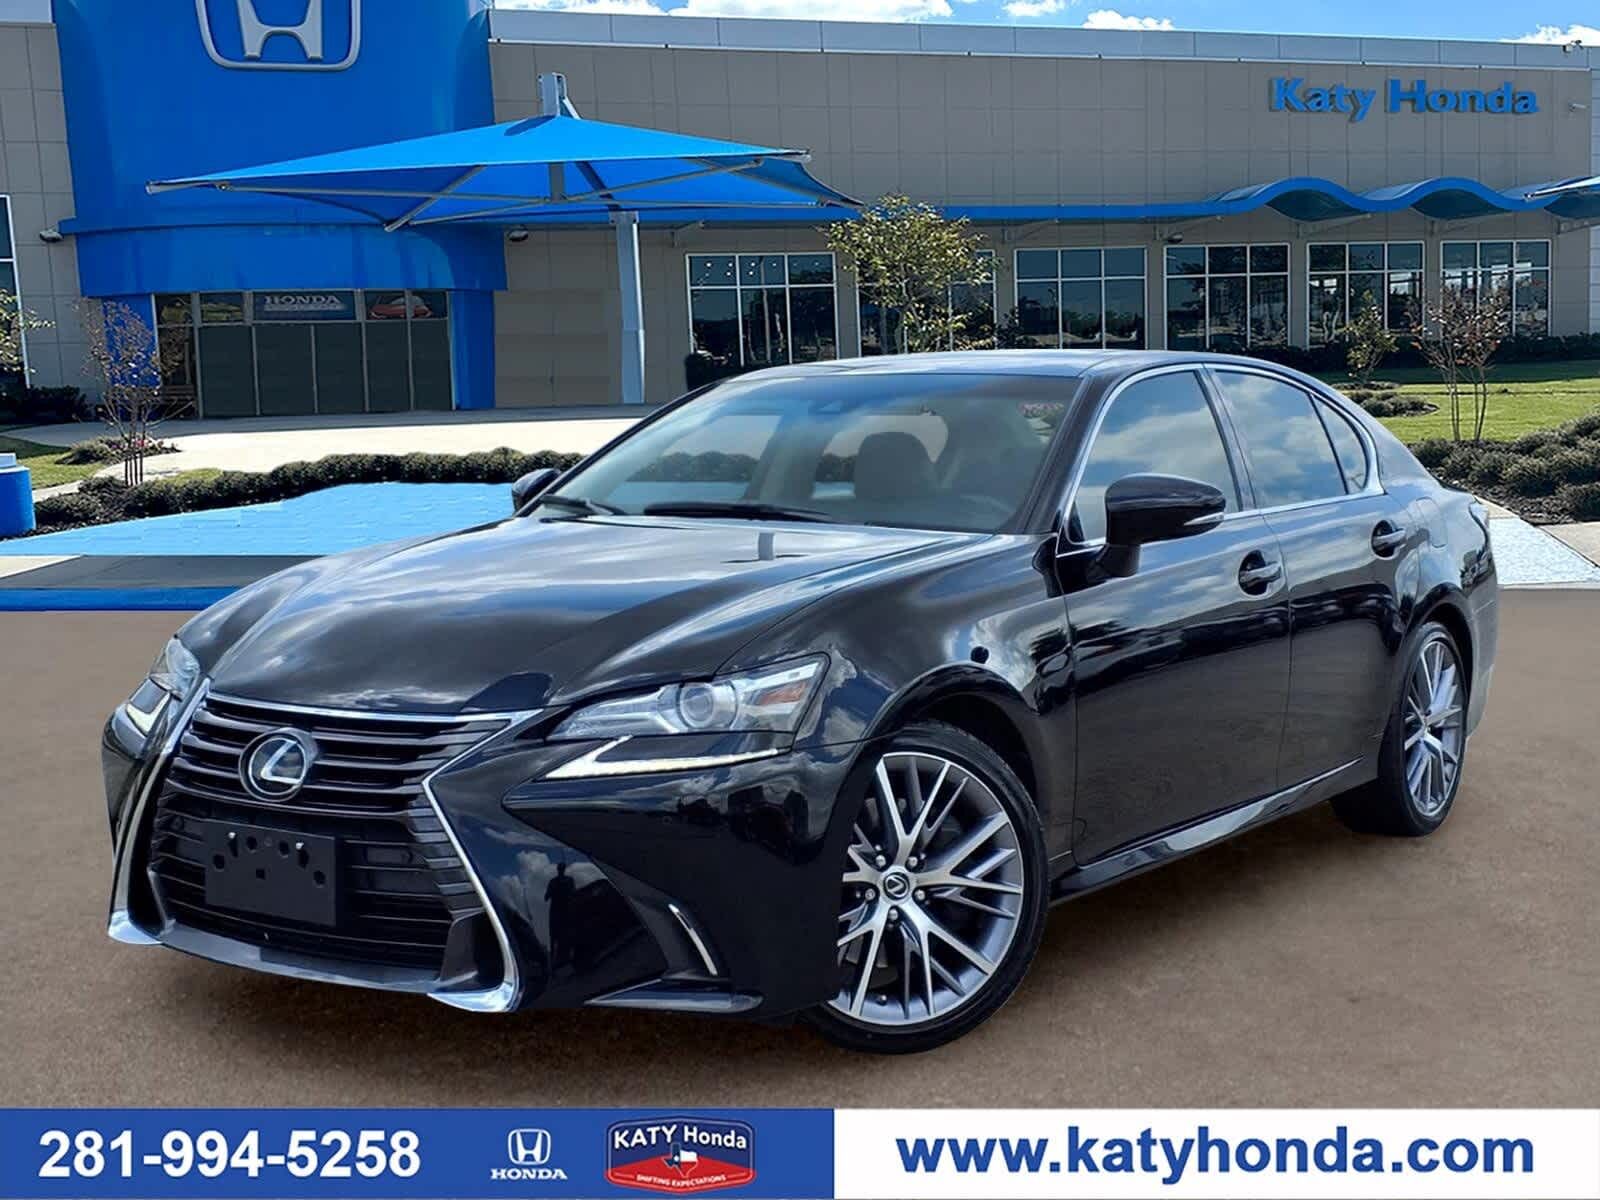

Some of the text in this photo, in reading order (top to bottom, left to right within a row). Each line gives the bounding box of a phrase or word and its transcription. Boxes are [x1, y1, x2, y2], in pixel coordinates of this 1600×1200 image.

[1271, 76, 1540, 122] Katy Honda
[263, 295, 341, 305] HONDA
